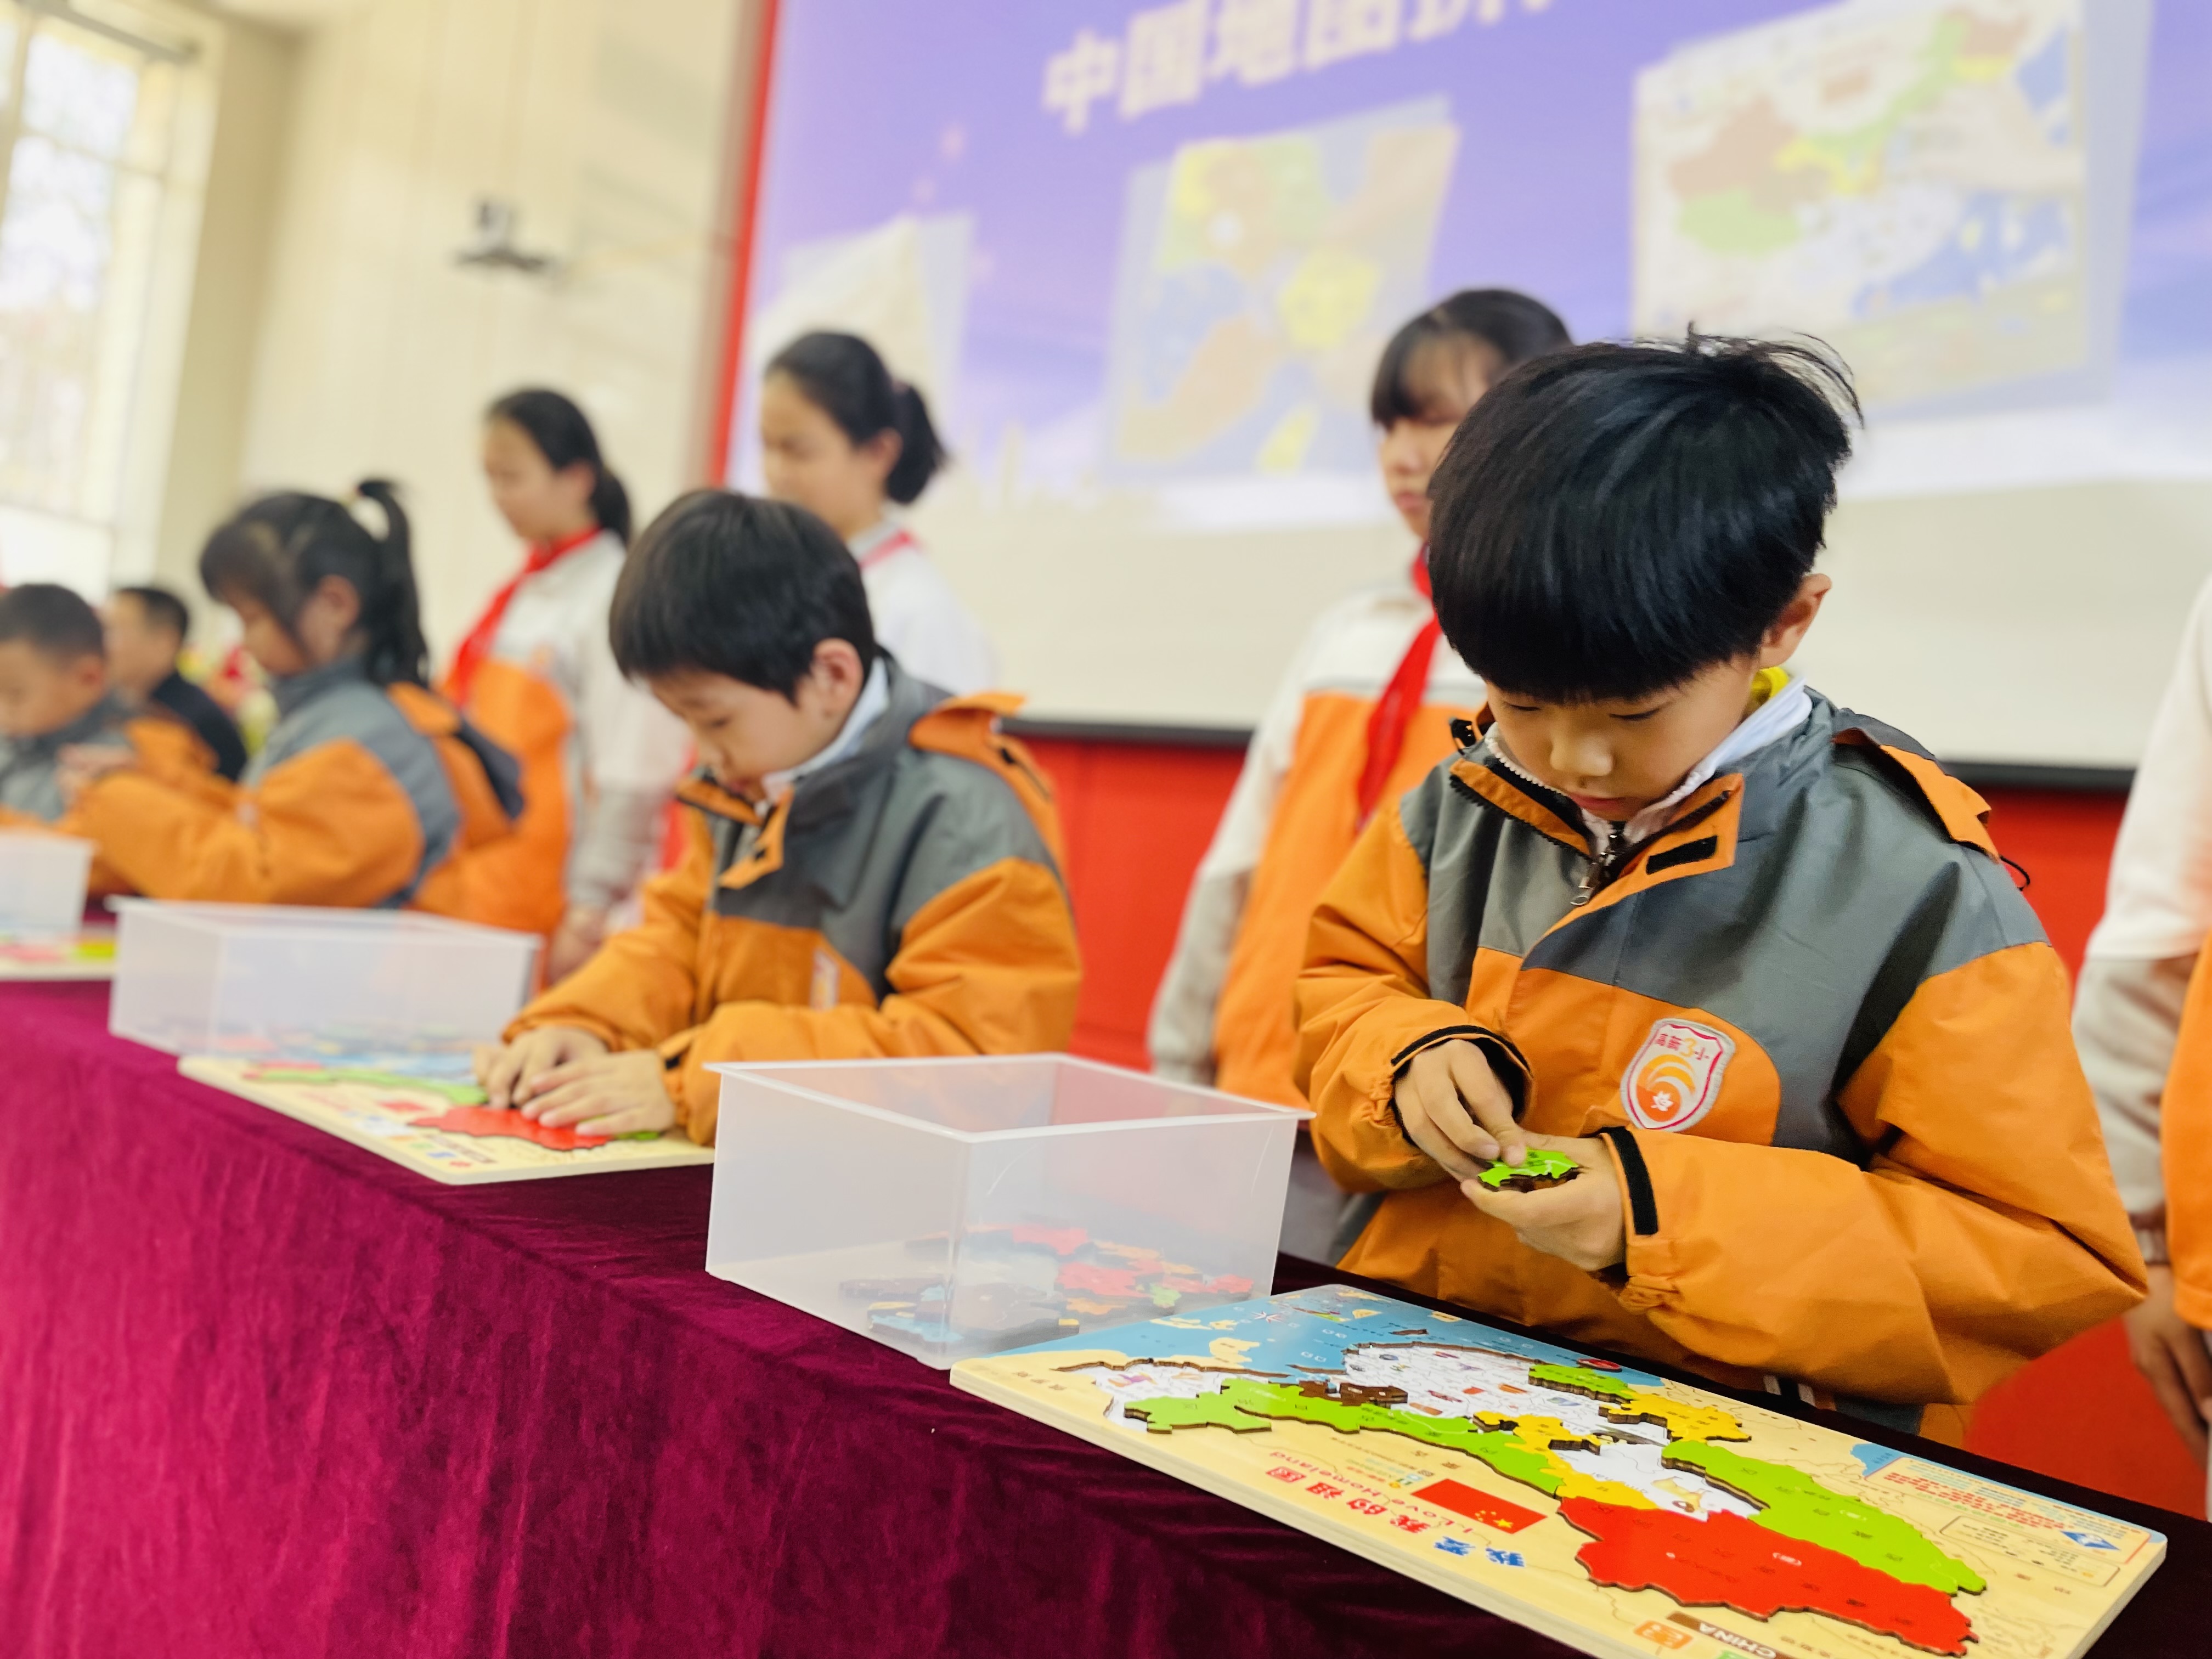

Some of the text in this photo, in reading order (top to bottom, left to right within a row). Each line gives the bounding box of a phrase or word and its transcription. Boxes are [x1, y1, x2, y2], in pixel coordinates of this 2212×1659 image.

[1269, 1452, 1382, 1496] Homeland
[1391, 1499, 1455, 1526] Love
[1699, 1623, 1777, 1659] CHINA
